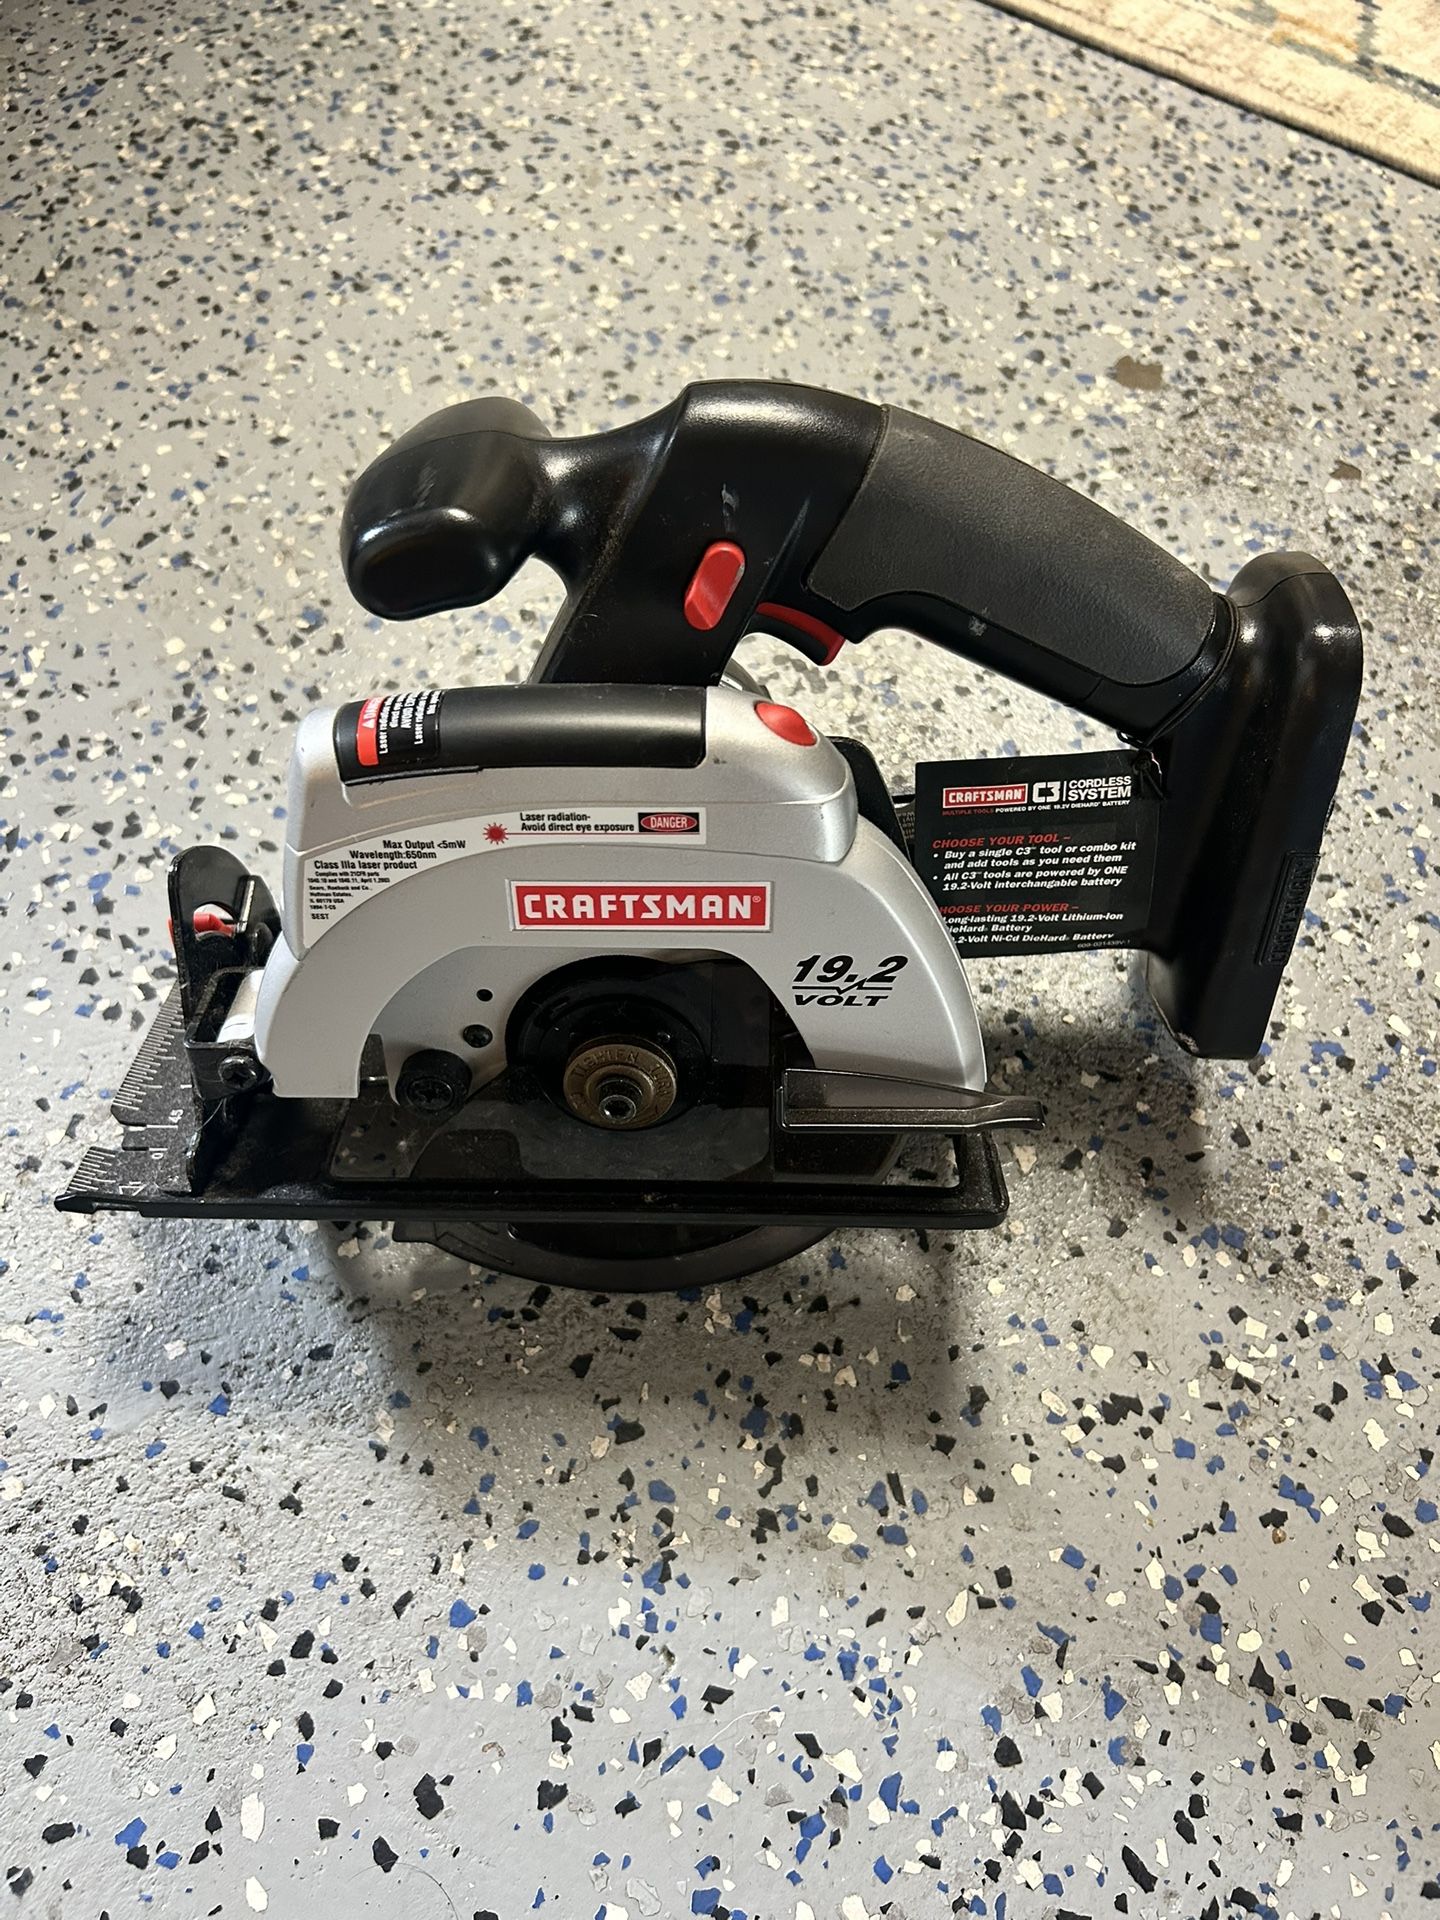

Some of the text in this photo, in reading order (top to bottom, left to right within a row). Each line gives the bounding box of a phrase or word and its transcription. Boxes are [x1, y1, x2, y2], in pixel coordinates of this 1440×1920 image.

[401, 707, 414, 728] AVOID
[414, 722, 424, 744] Laser
[379, 731, 388, 754] Laser
[1068, 775, 1131, 789] CORDLESS
[1032, 781, 1060, 803] C3
[1068, 786, 1131, 801] SYSTEM
[995, 806, 1026, 814] POWERED
[1102, 799, 1130, 807] BATTERY
[520, 812, 591, 821] Laser radiation-
[650, 816, 688, 828] DANGER
[521, 822, 634, 834] Avoid direct eye exposure
[383, 840, 466, 850] Max Output <5mW
[932, 837, 985, 849] CHOOSE
[989, 835, 1024, 846] YOUR
[1028, 833, 1060, 844] TOOL
[350, 850, 437, 860] Wavelength:650nm
[944, 850, 965, 861] Buy
[978, 847, 1013, 859] single
[1039, 844, 1062, 854] tool
[1065, 845, 1075, 853] or
[1077, 843, 1118, 853] combo
[1120, 841, 1136, 851] kit
[314, 861, 339, 869] Class
[358, 861, 381, 869] laser
[384, 861, 417, 870] product
[944, 853, 1123, 870] and add tools as you need them
[943, 871, 959, 881] All
[983, 869, 1012, 879] tools
[1014, 870, 1033, 878] are
[1035, 866, 1084, 879] powered
[1087, 866, 1101, 877] by
[1103, 865, 1128, 875] ONE
[942, 877, 1123, 892] 19.2-Volt interchangable battery
[938, 904, 981, 914] HOOSE
[985, 903, 1020, 913] YOUR
[1022, 903, 1069, 913] POWER
[1010, 913, 1059, 923] 19.2-Volt
[1062, 912, 1124, 922] Lithium-Ion
[991, 924, 1033, 933] Battery
[991, 934, 1019, 943] Ni-Cd
[1073, 932, 1114, 941] Battery
[793, 955, 908, 983] 19.2
[795, 995, 889, 1006] VOLT
[168, 1109, 184, 1124] 45
